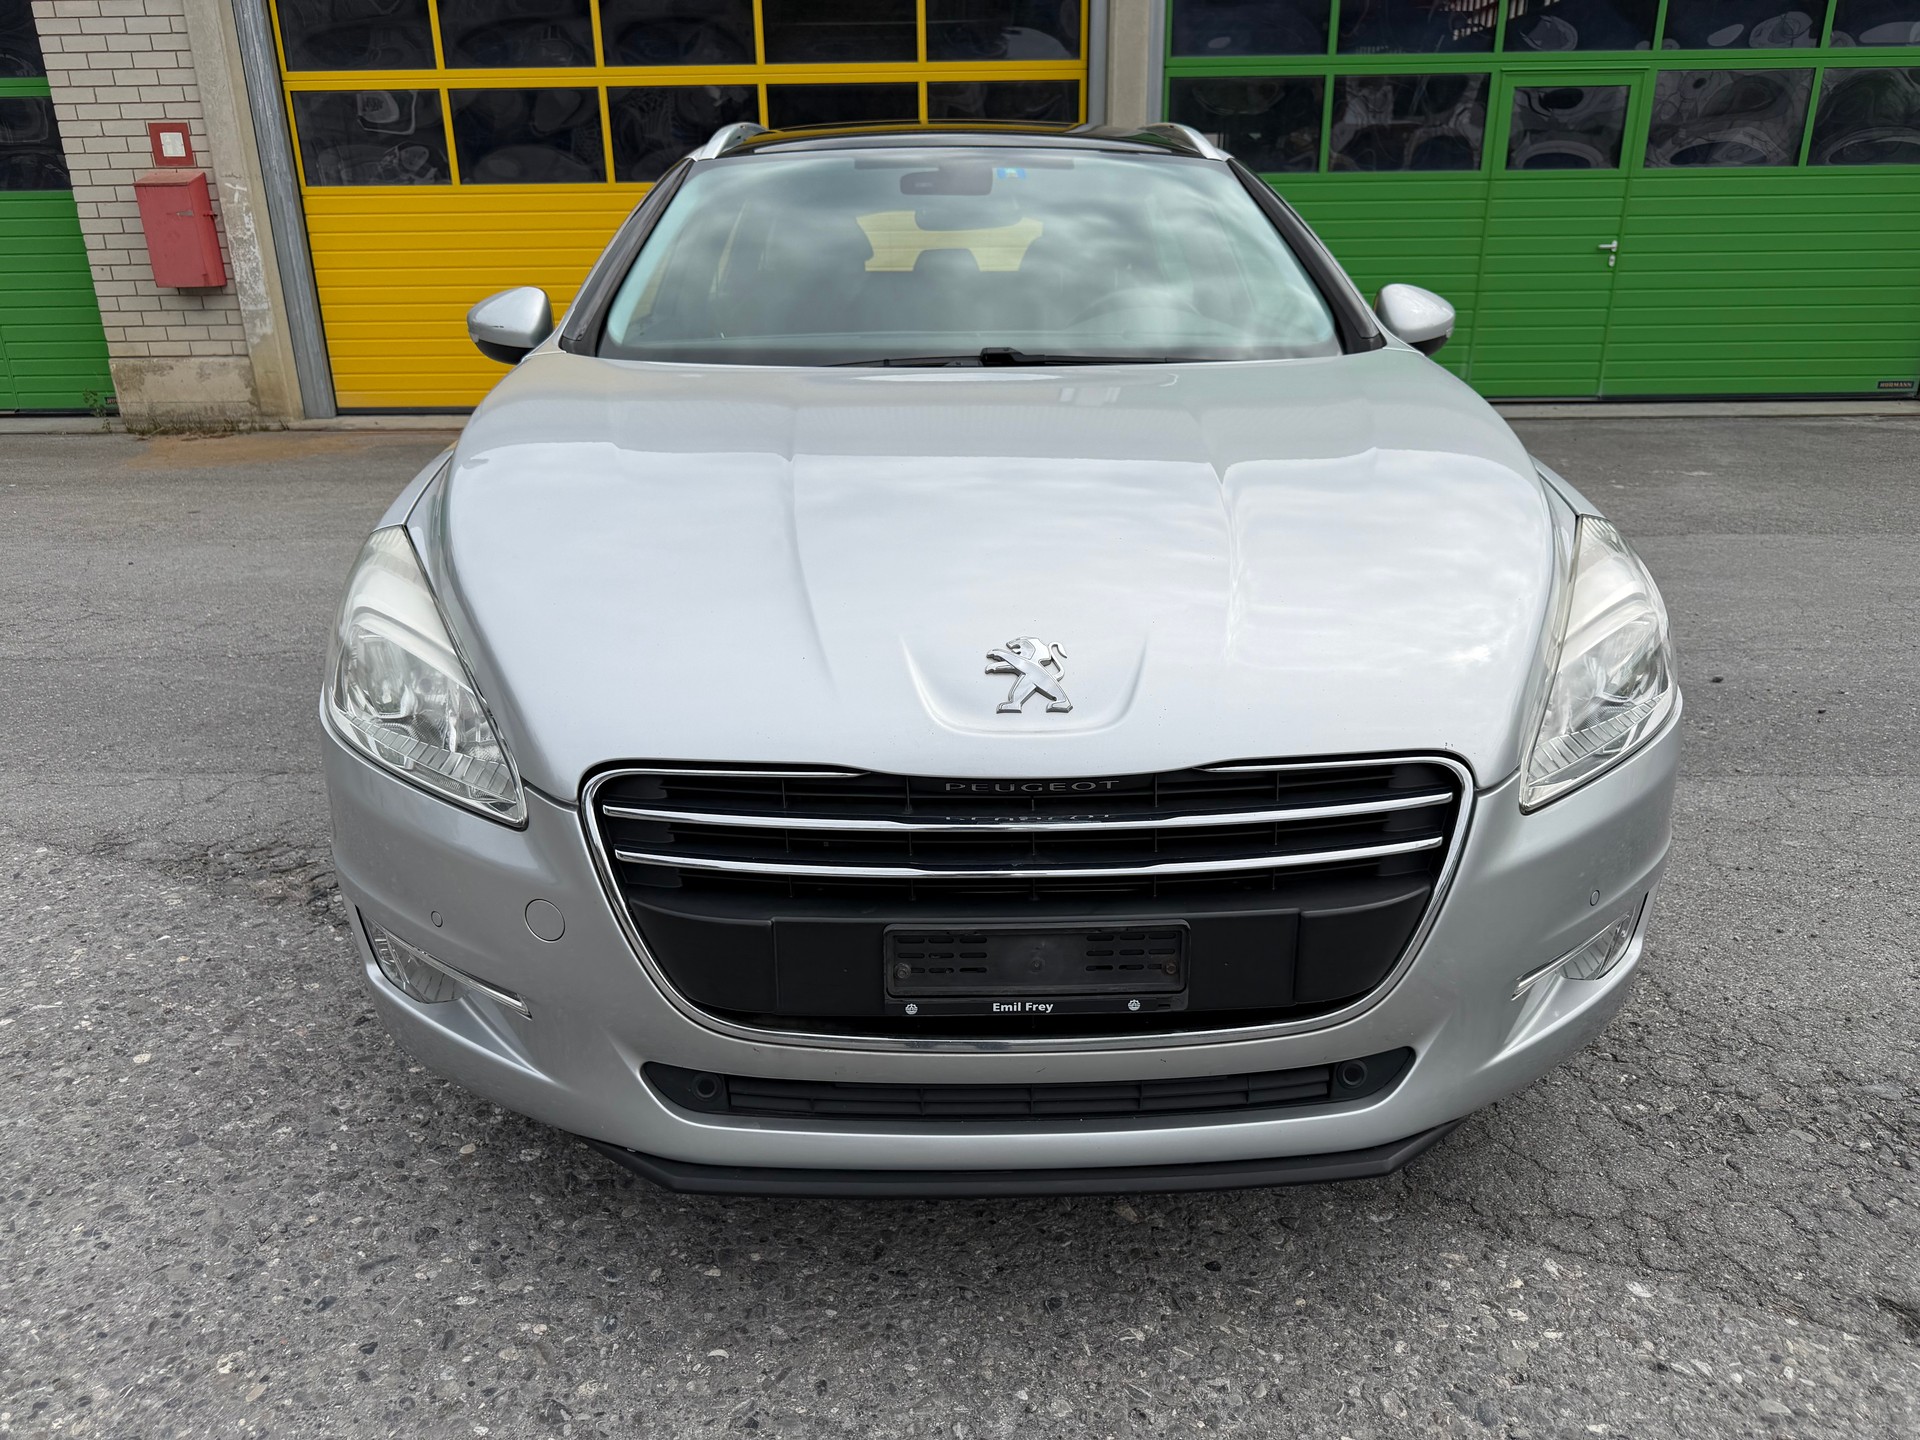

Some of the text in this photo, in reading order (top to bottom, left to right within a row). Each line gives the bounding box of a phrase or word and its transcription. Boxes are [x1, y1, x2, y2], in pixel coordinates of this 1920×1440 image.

[945, 780, 1120, 792] PEUGEOT
[992, 1002, 1054, 1013] Emil Frey
